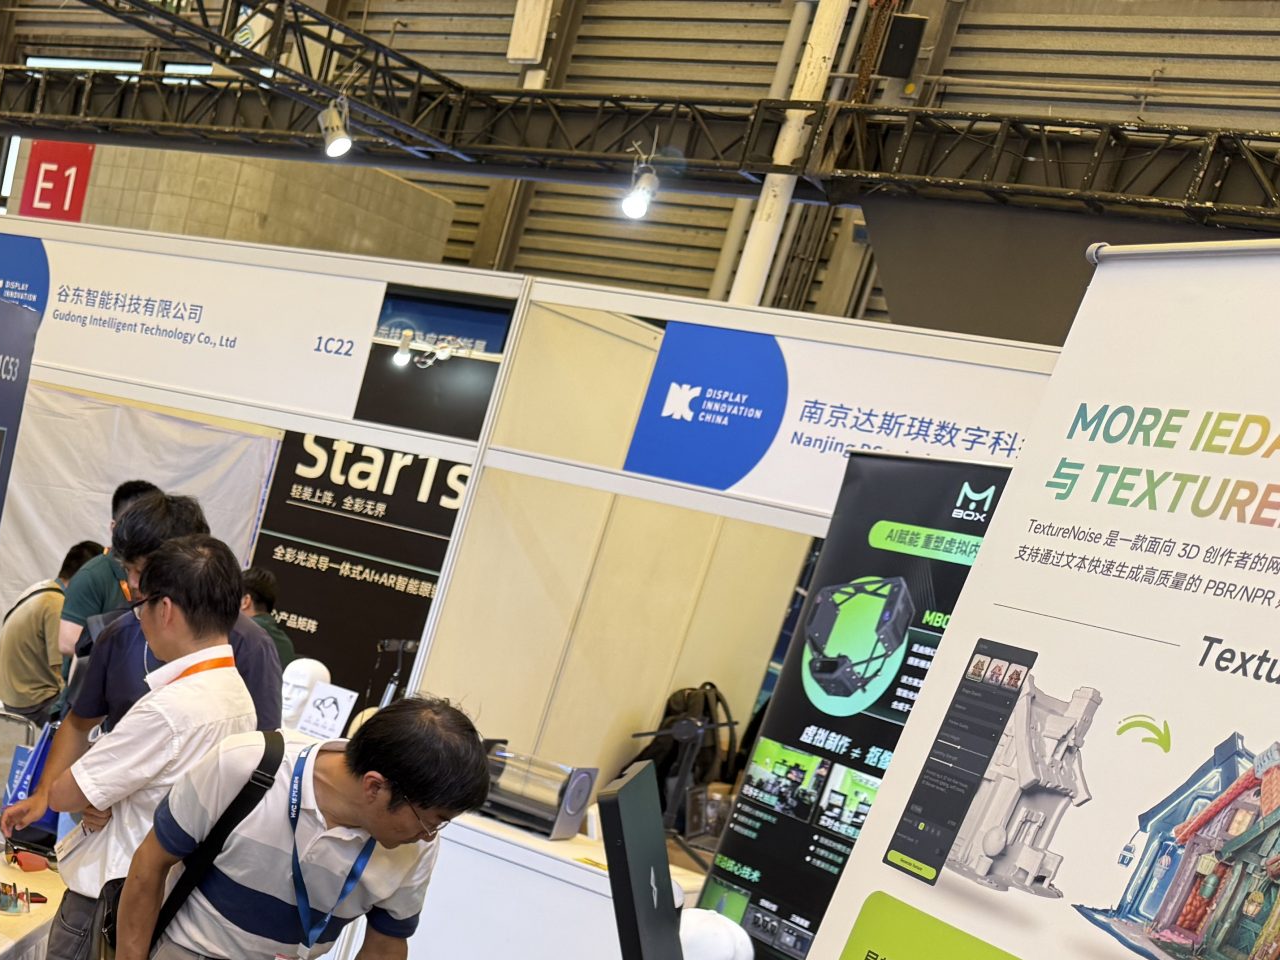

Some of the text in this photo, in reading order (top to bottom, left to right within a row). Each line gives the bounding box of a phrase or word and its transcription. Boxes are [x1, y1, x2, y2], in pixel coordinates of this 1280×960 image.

[32, 162, 77, 211] E1
[56, 284, 204, 323] 谷东智能科技有限公司
[52, 308, 237, 349] Gudong Intelligent Technology Co., Ltd
[314, 336, 354, 357] 1C22
[701, 399, 763, 420] INNOVATION
[705, 387, 749, 404] DISPLAY
[698, 411, 730, 426] CHINA
[799, 398, 1025, 460] 南京达斯琪数字科
[1066, 402, 1190, 449] MORE
[791, 431, 855, 458] Nanjing
[290, 483, 387, 518] 轻装上阵，全彩无界
[1045, 457, 1280, 529] 与 TEXTURE
[951, 508, 987, 523] BOX
[885, 528, 920, 548] AI赋能
[1027, 518, 1102, 545] TextureNoise
[1103, 530, 1176, 557] 是一款面向
[1178, 542, 1201, 561] 3D
[1014, 545, 1276, 607] 支持通过文本快速生成高质量的 PBR/NPR
[799, 725, 852, 755] 虚拟制作
